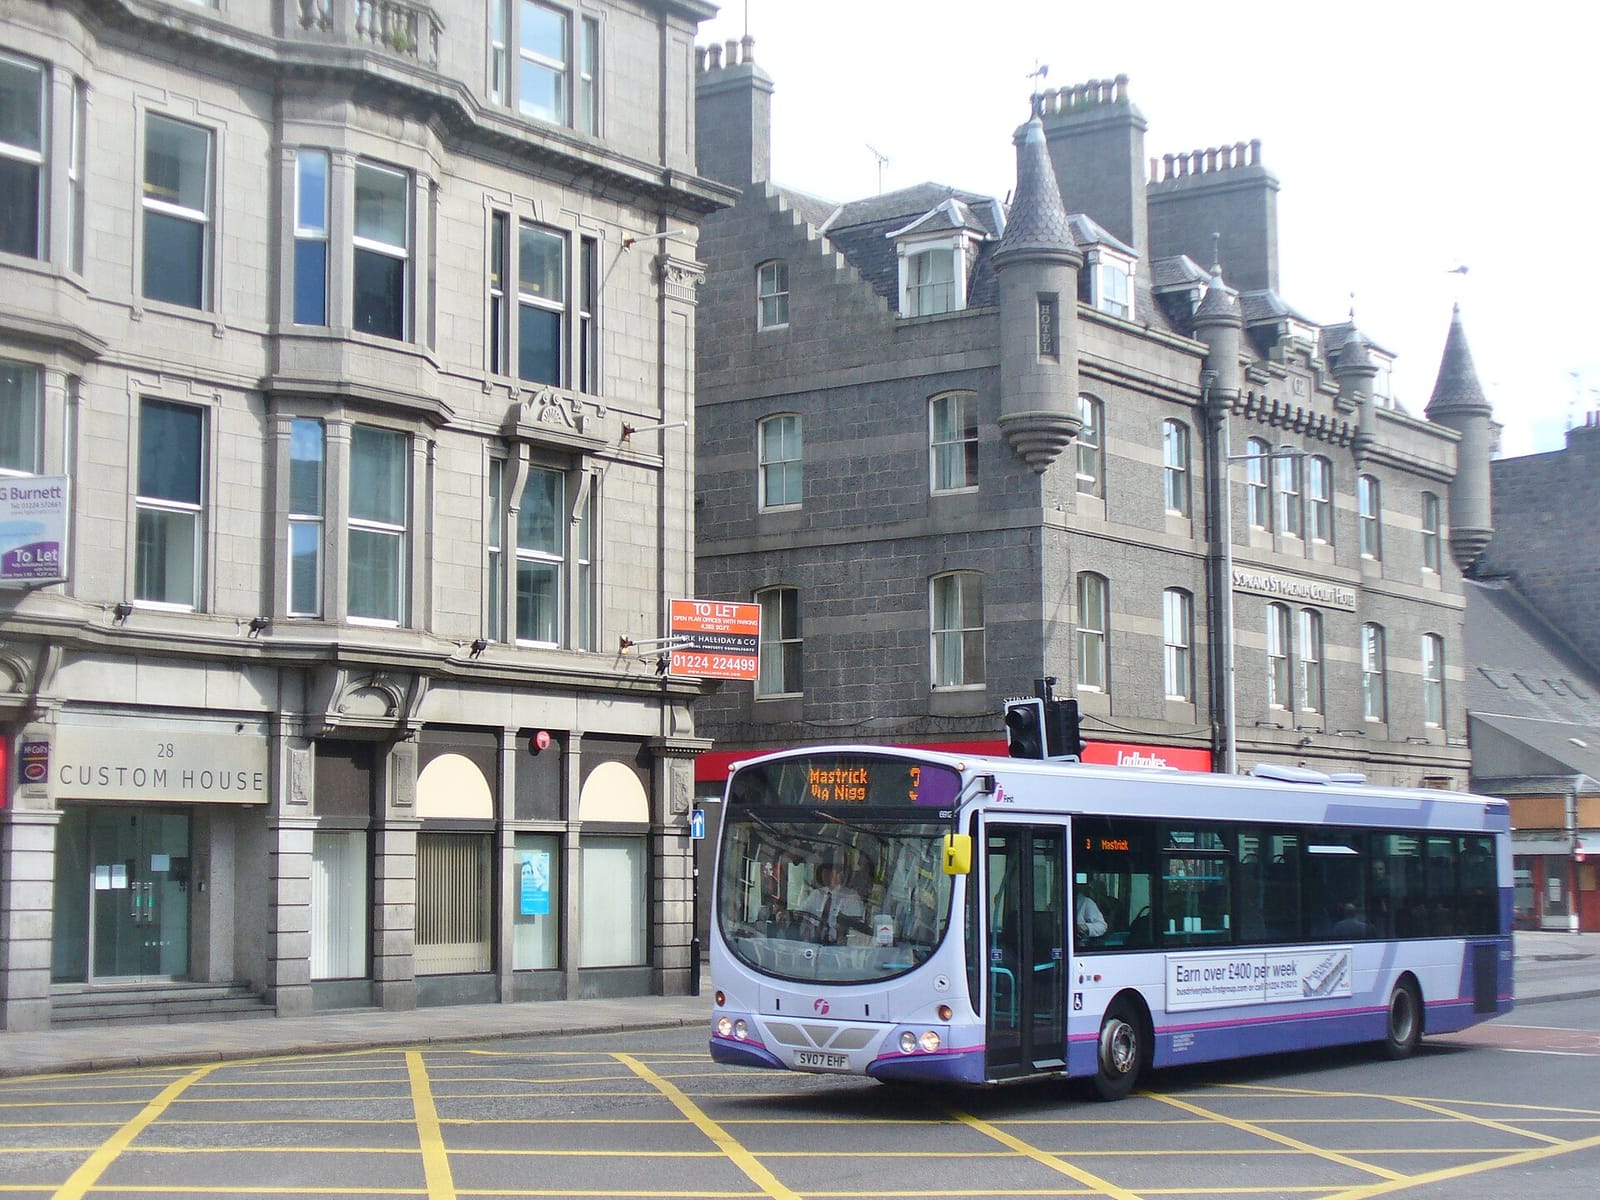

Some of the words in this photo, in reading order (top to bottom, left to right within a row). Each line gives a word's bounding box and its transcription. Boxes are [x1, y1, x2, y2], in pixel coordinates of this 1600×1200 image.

[1041, 305, 1051, 352] HOTEL
[10, 485, 62, 500] Burnett
[15, 549, 31, 562] To
[37, 548, 58, 562] Let
[693, 603, 711, 616] TO
[716, 605, 739, 618] LET
[698, 636, 736, 645] HALLIDAY
[673, 654, 709, 669] 01224
[712, 656, 755, 672] 224499
[157, 743, 174, 758] 28
[1117, 750, 1167, 768] Ladbrokes
[59, 765, 167, 789] CUSTOM
[182, 769, 264, 791] HOUSE
[809, 768, 868, 784] Mastrick
[834, 784, 866, 800] Nigg
[1101, 839, 1129, 851] Mastrick
[1176, 965, 1201, 983] Earn
[1203, 967, 1226, 982] over
[1228, 962, 1251, 980] £400
[1254, 966, 1271, 983] per
[1272, 960, 1297, 977] week
[800, 1053, 825, 1065] SV07
[827, 1056, 846, 1067] EHF
